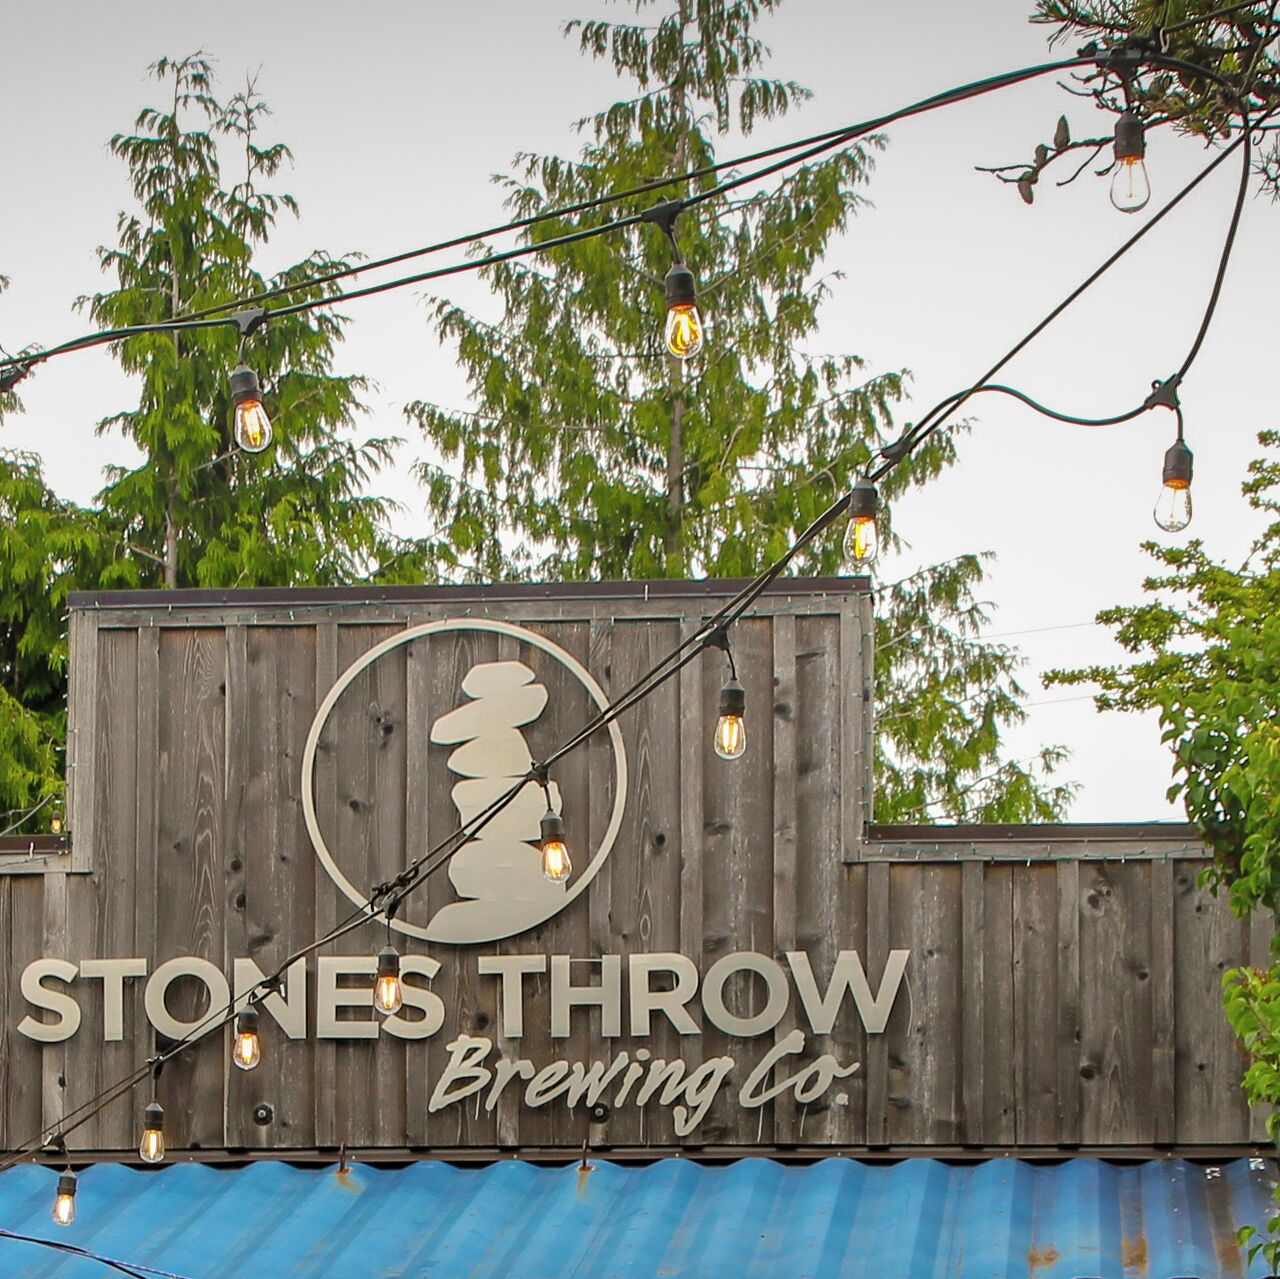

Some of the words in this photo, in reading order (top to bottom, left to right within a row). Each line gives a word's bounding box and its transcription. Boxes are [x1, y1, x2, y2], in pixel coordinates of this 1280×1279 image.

[17, 955, 446, 1043] STONES
[478, 949, 911, 1038] THROW
[428, 1033, 735, 1137] Brewing
[738, 1029, 861, 1108] Co.
